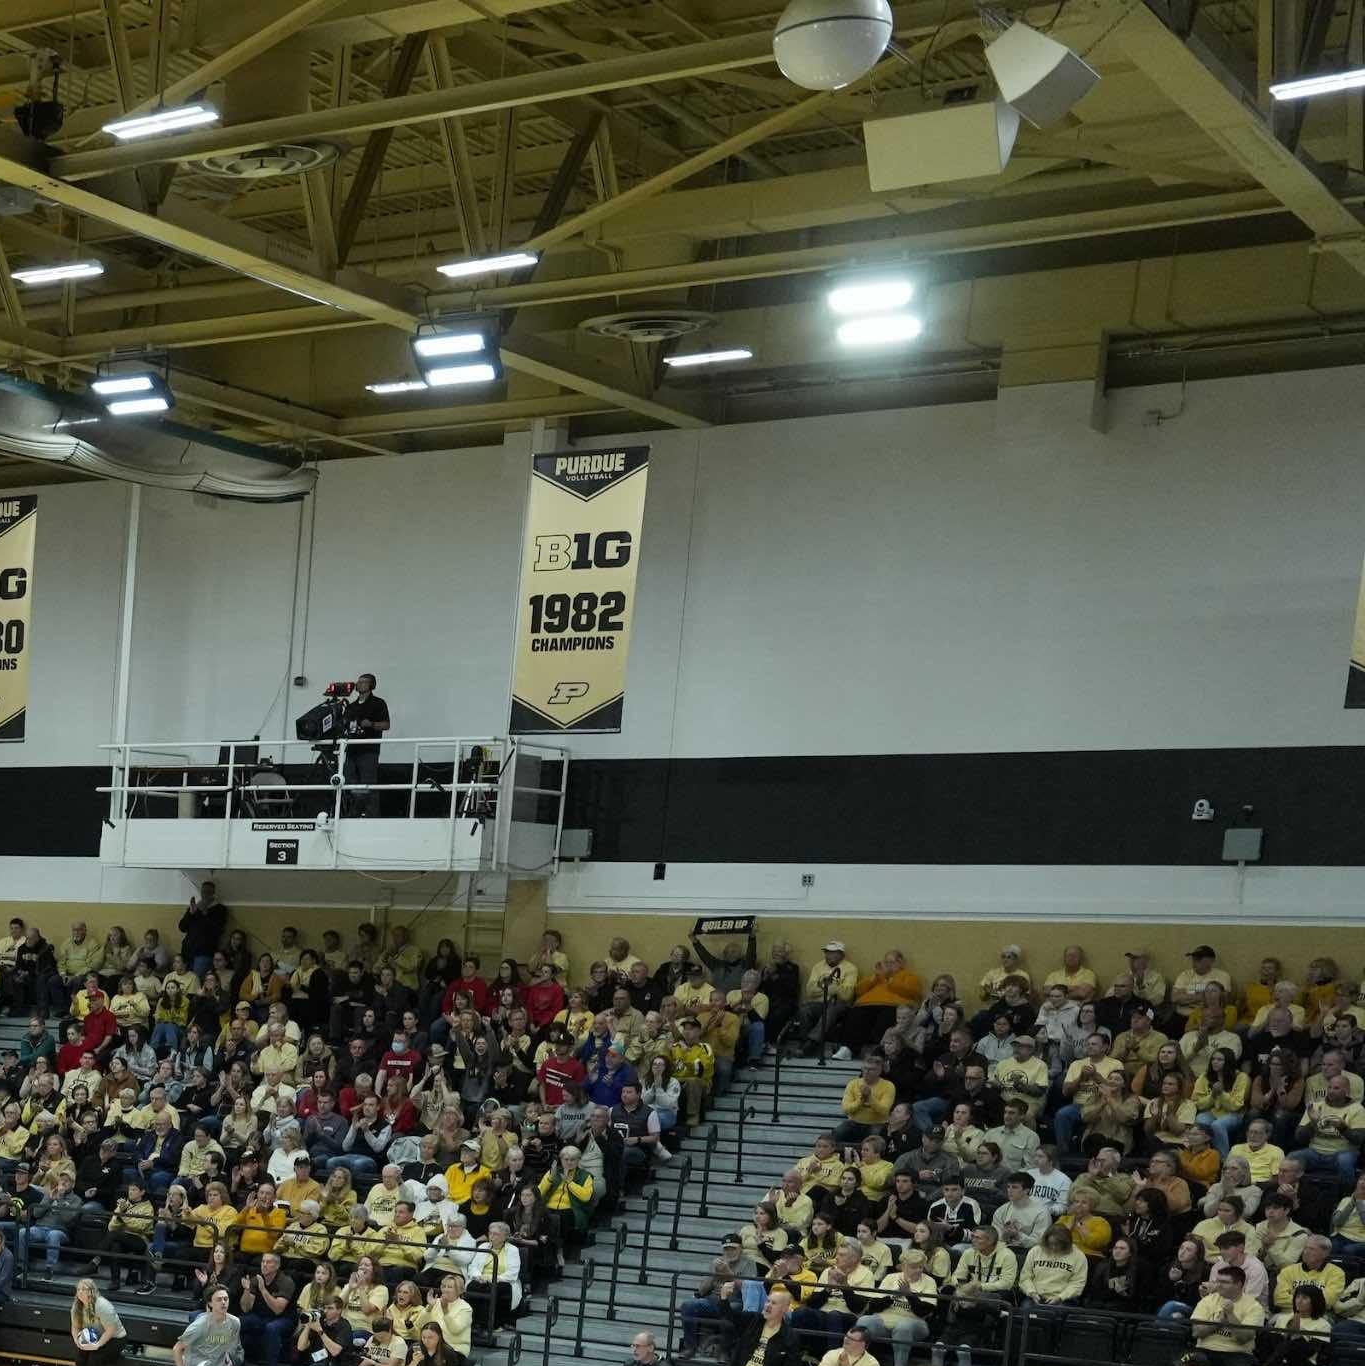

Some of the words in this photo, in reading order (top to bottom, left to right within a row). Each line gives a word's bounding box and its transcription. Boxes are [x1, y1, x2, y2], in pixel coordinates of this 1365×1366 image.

[555, 453, 626, 476] PURDUE
[565, 472, 613, 482] VOLLEYBALL
[529, 590, 626, 634] 1982
[531, 635, 615, 652] CHAMPIONS
[277, 851, 287, 861] 3
[734, 919, 748, 929] UP
[1033, 1259, 1073, 1272] PURDUE
